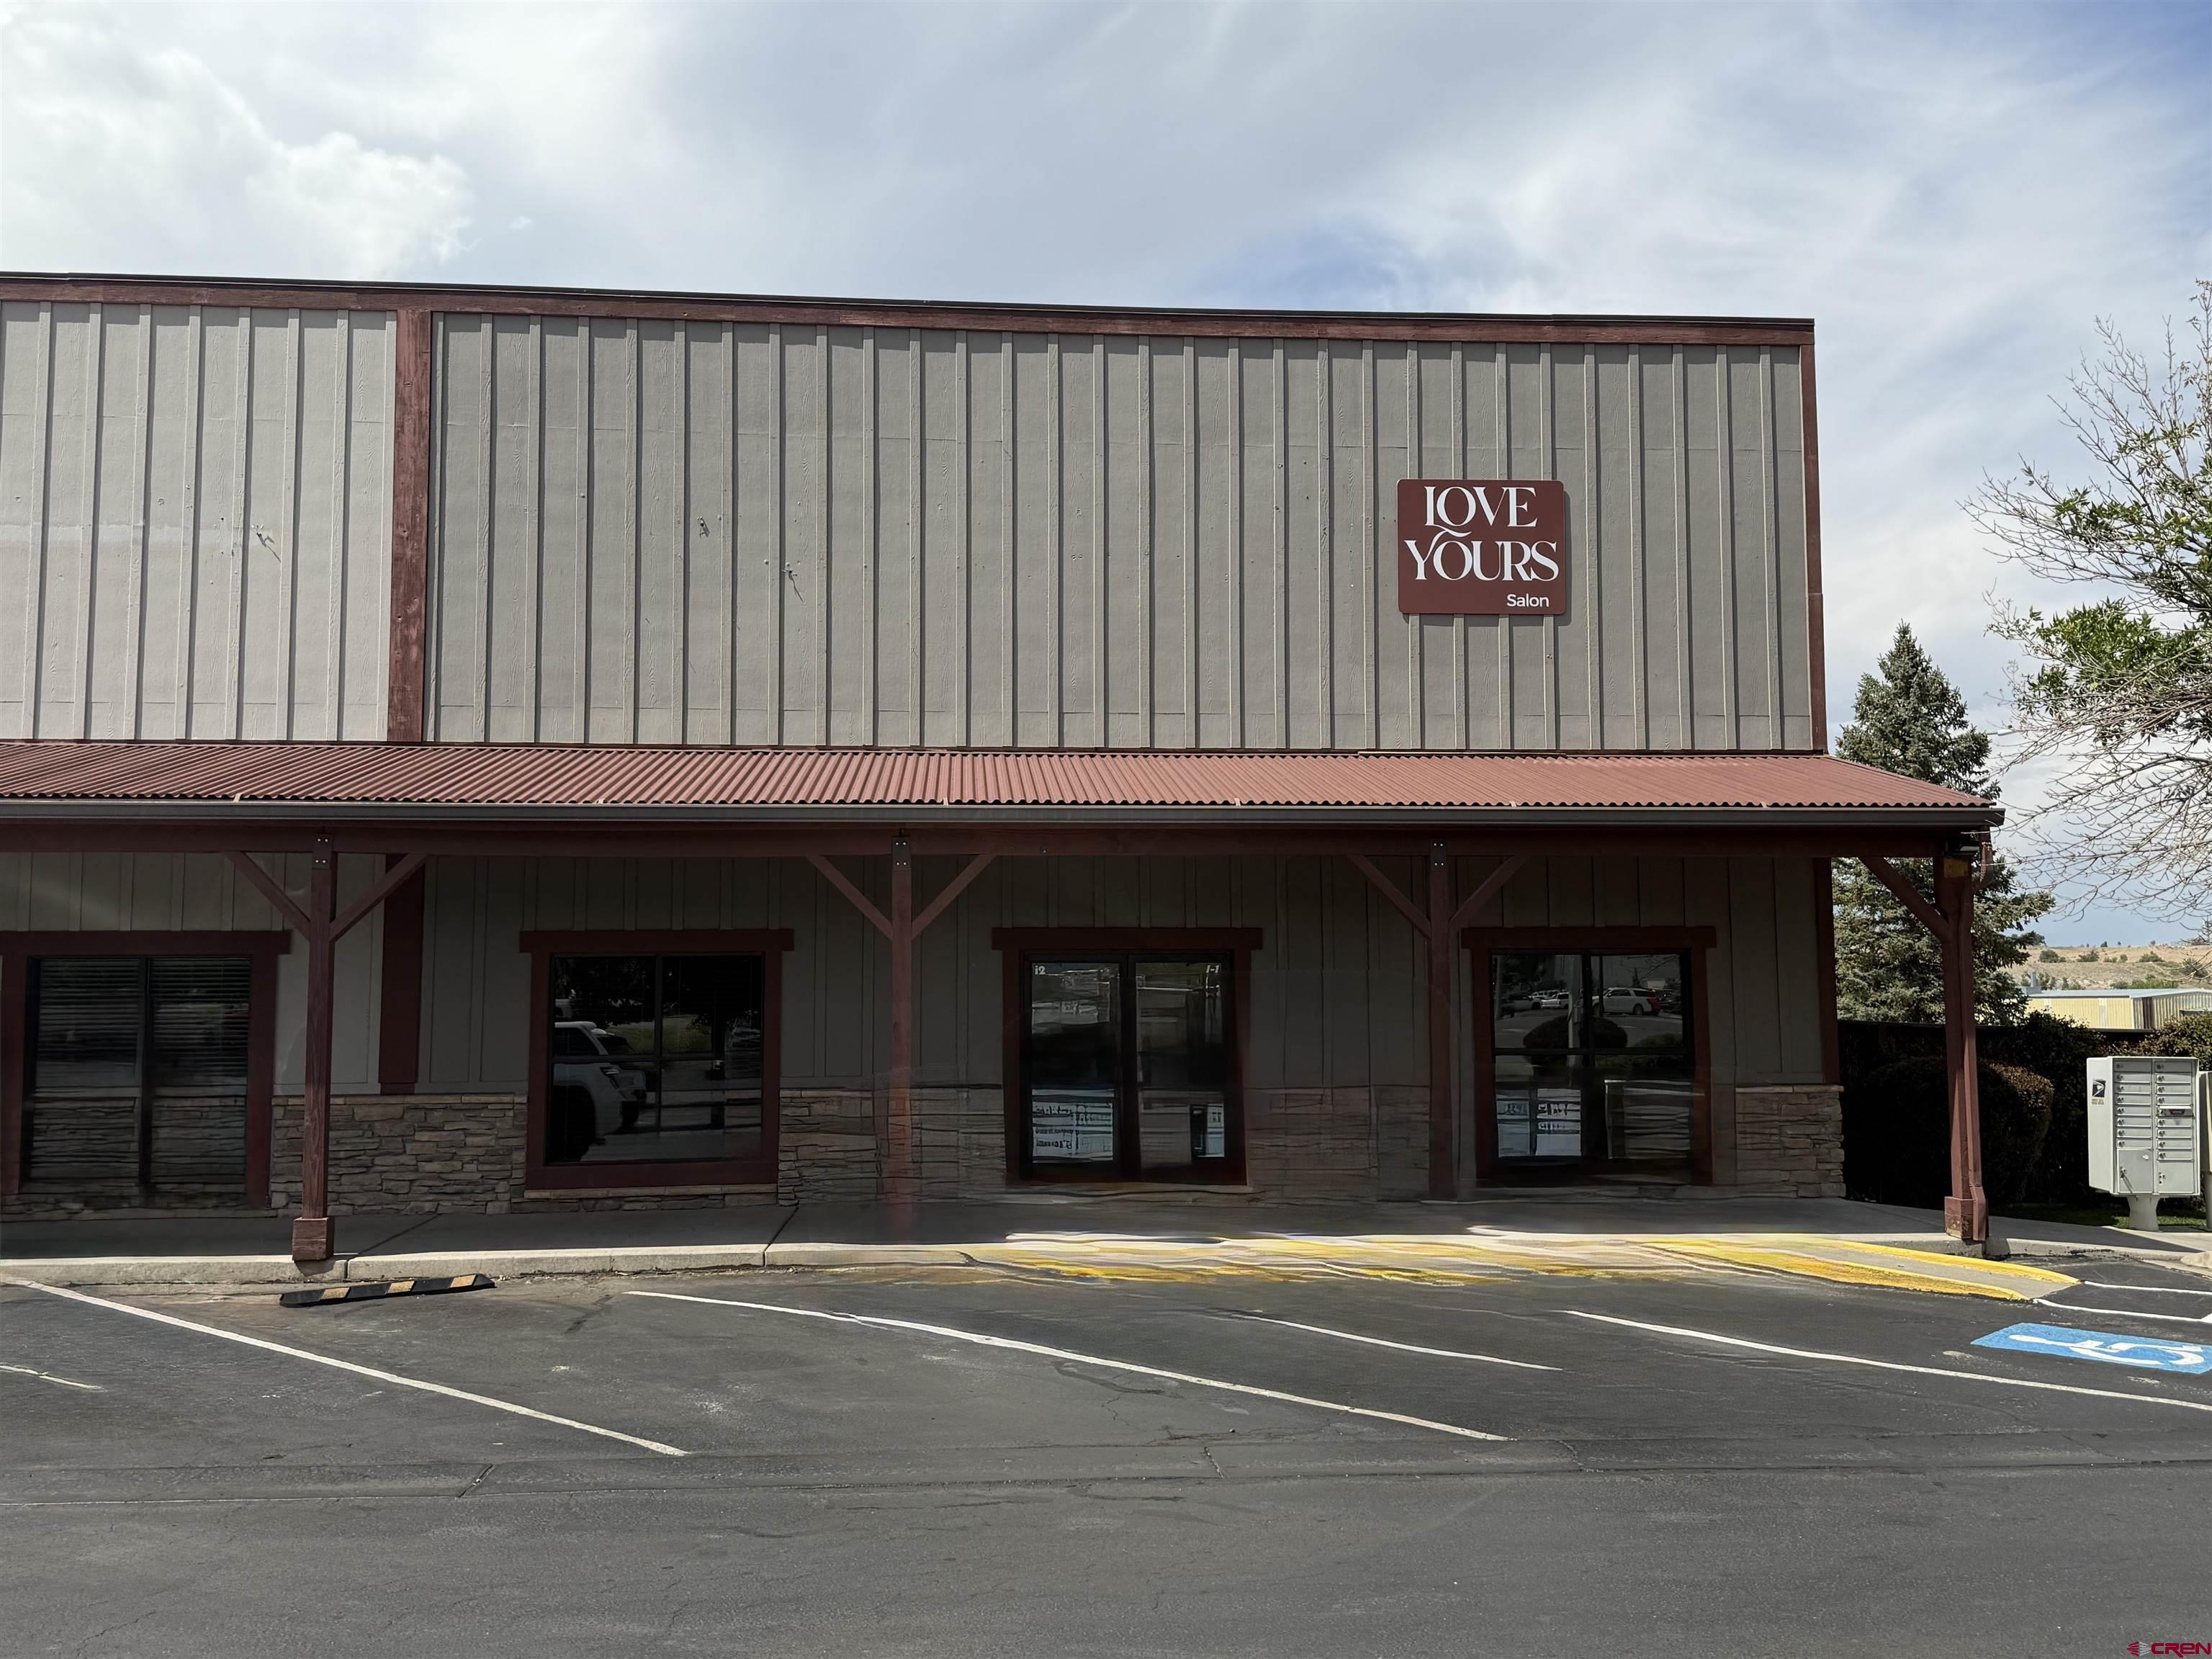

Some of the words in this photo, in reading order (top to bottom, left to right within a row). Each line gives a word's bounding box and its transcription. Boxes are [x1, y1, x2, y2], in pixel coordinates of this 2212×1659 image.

[1424, 486, 1538, 529] LOVE
[1404, 539, 1559, 581] YOURS
[1506, 593, 1550, 607] Salon
